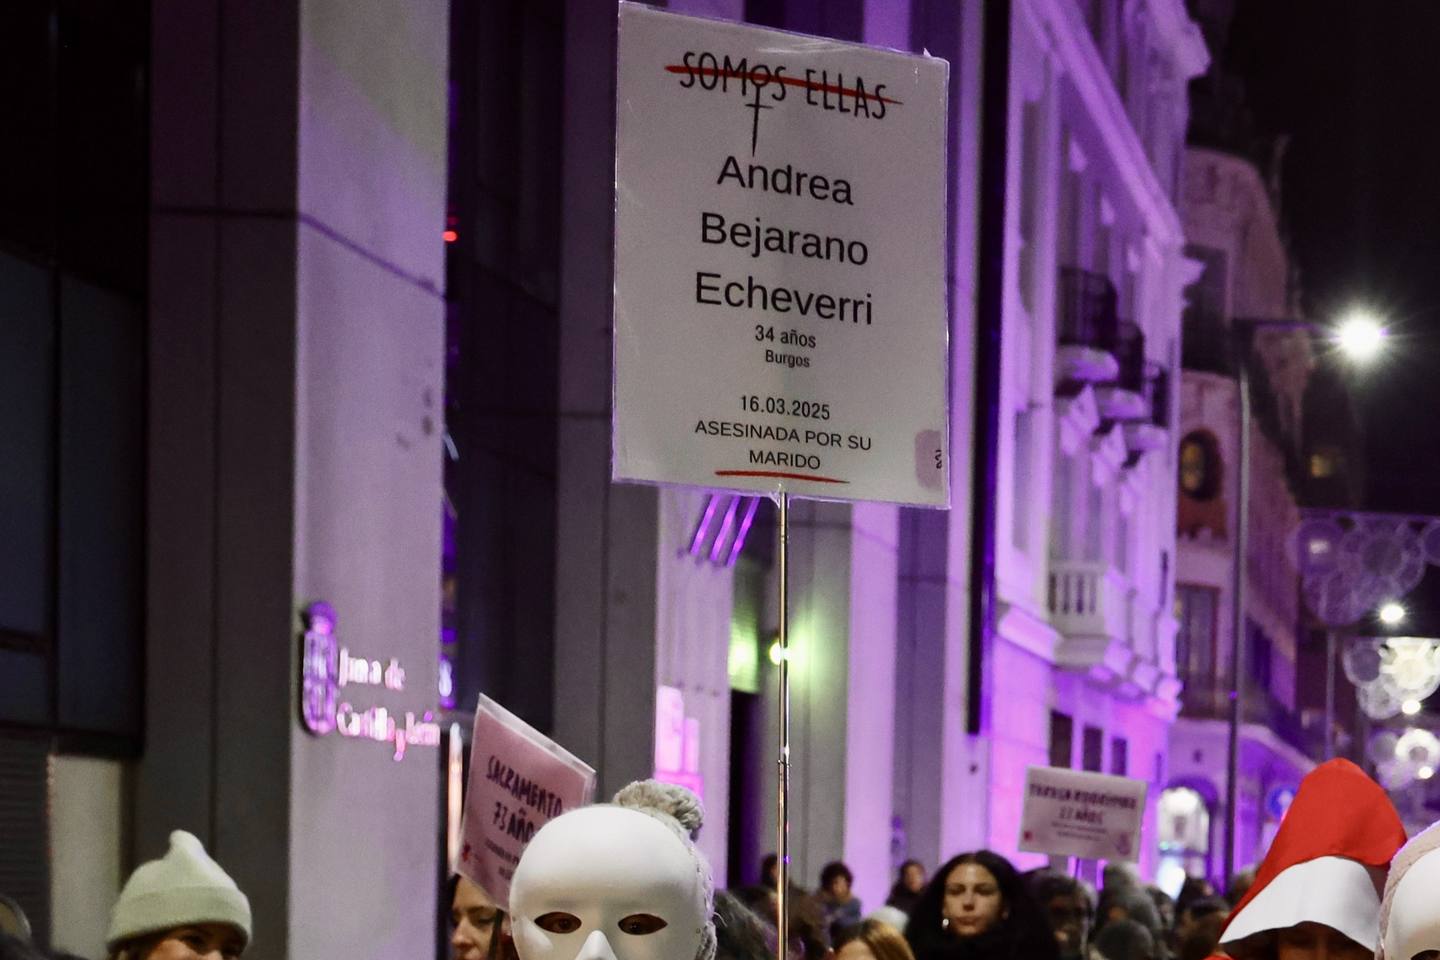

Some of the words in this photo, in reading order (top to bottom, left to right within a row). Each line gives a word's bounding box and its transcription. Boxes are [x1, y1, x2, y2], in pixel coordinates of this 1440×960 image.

[680, 51, 786, 102] SOMOS
[805, 69, 887, 120] ELLAS
[717, 155, 854, 206] Andrea
[701, 211, 869, 266] Bejarano
[695, 271, 873, 325] Echeverri
[755, 325, 775, 342] 34
[780, 330, 817, 349] años
[765, 349, 811, 368] Burgos
[740, 395, 830, 420] 16.03.2025
[694, 420, 800, 443] ASESINADA
[805, 430, 842, 448] POR
[848, 435, 872, 451] SU
[749, 450, 821, 470] MARIDO
